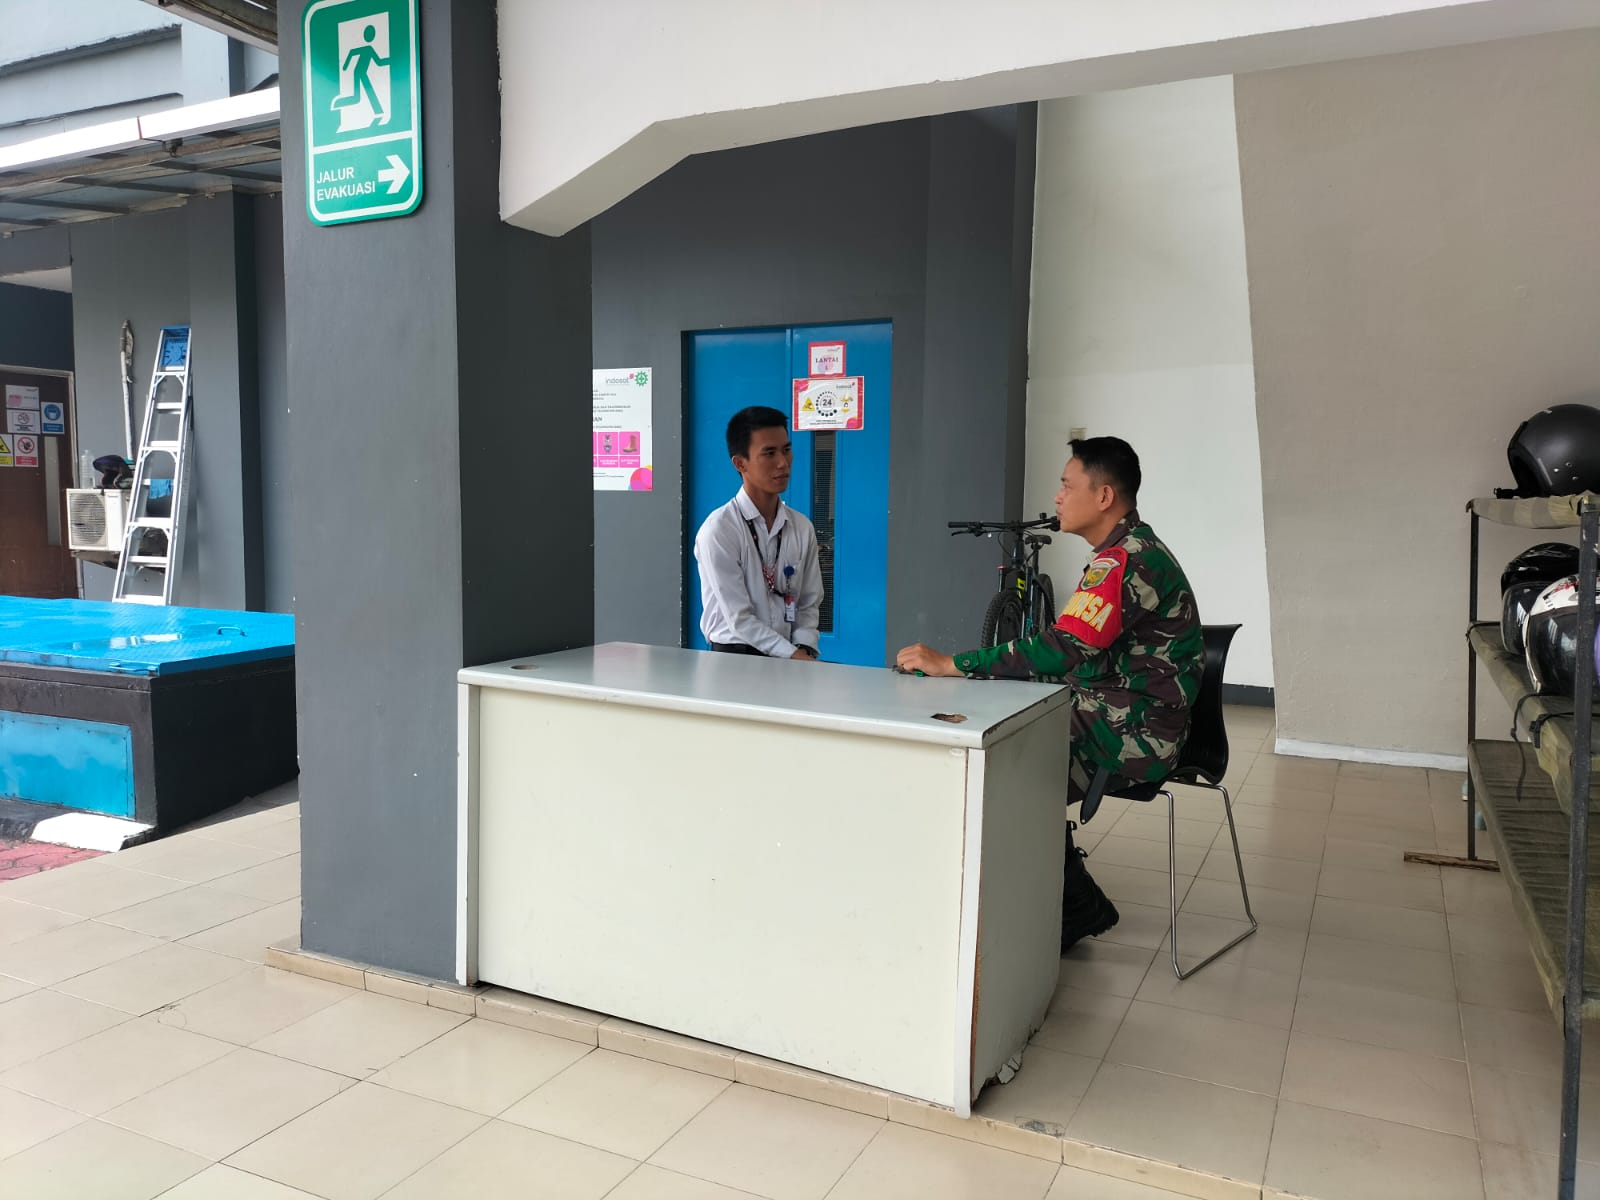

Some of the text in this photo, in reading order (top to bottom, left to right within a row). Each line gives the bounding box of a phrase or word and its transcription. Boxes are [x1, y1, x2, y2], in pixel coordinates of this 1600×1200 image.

[316, 167, 354, 184] JALUR
[316, 181, 376, 202] EVAKUASI
[822, 399, 832, 407] 24
